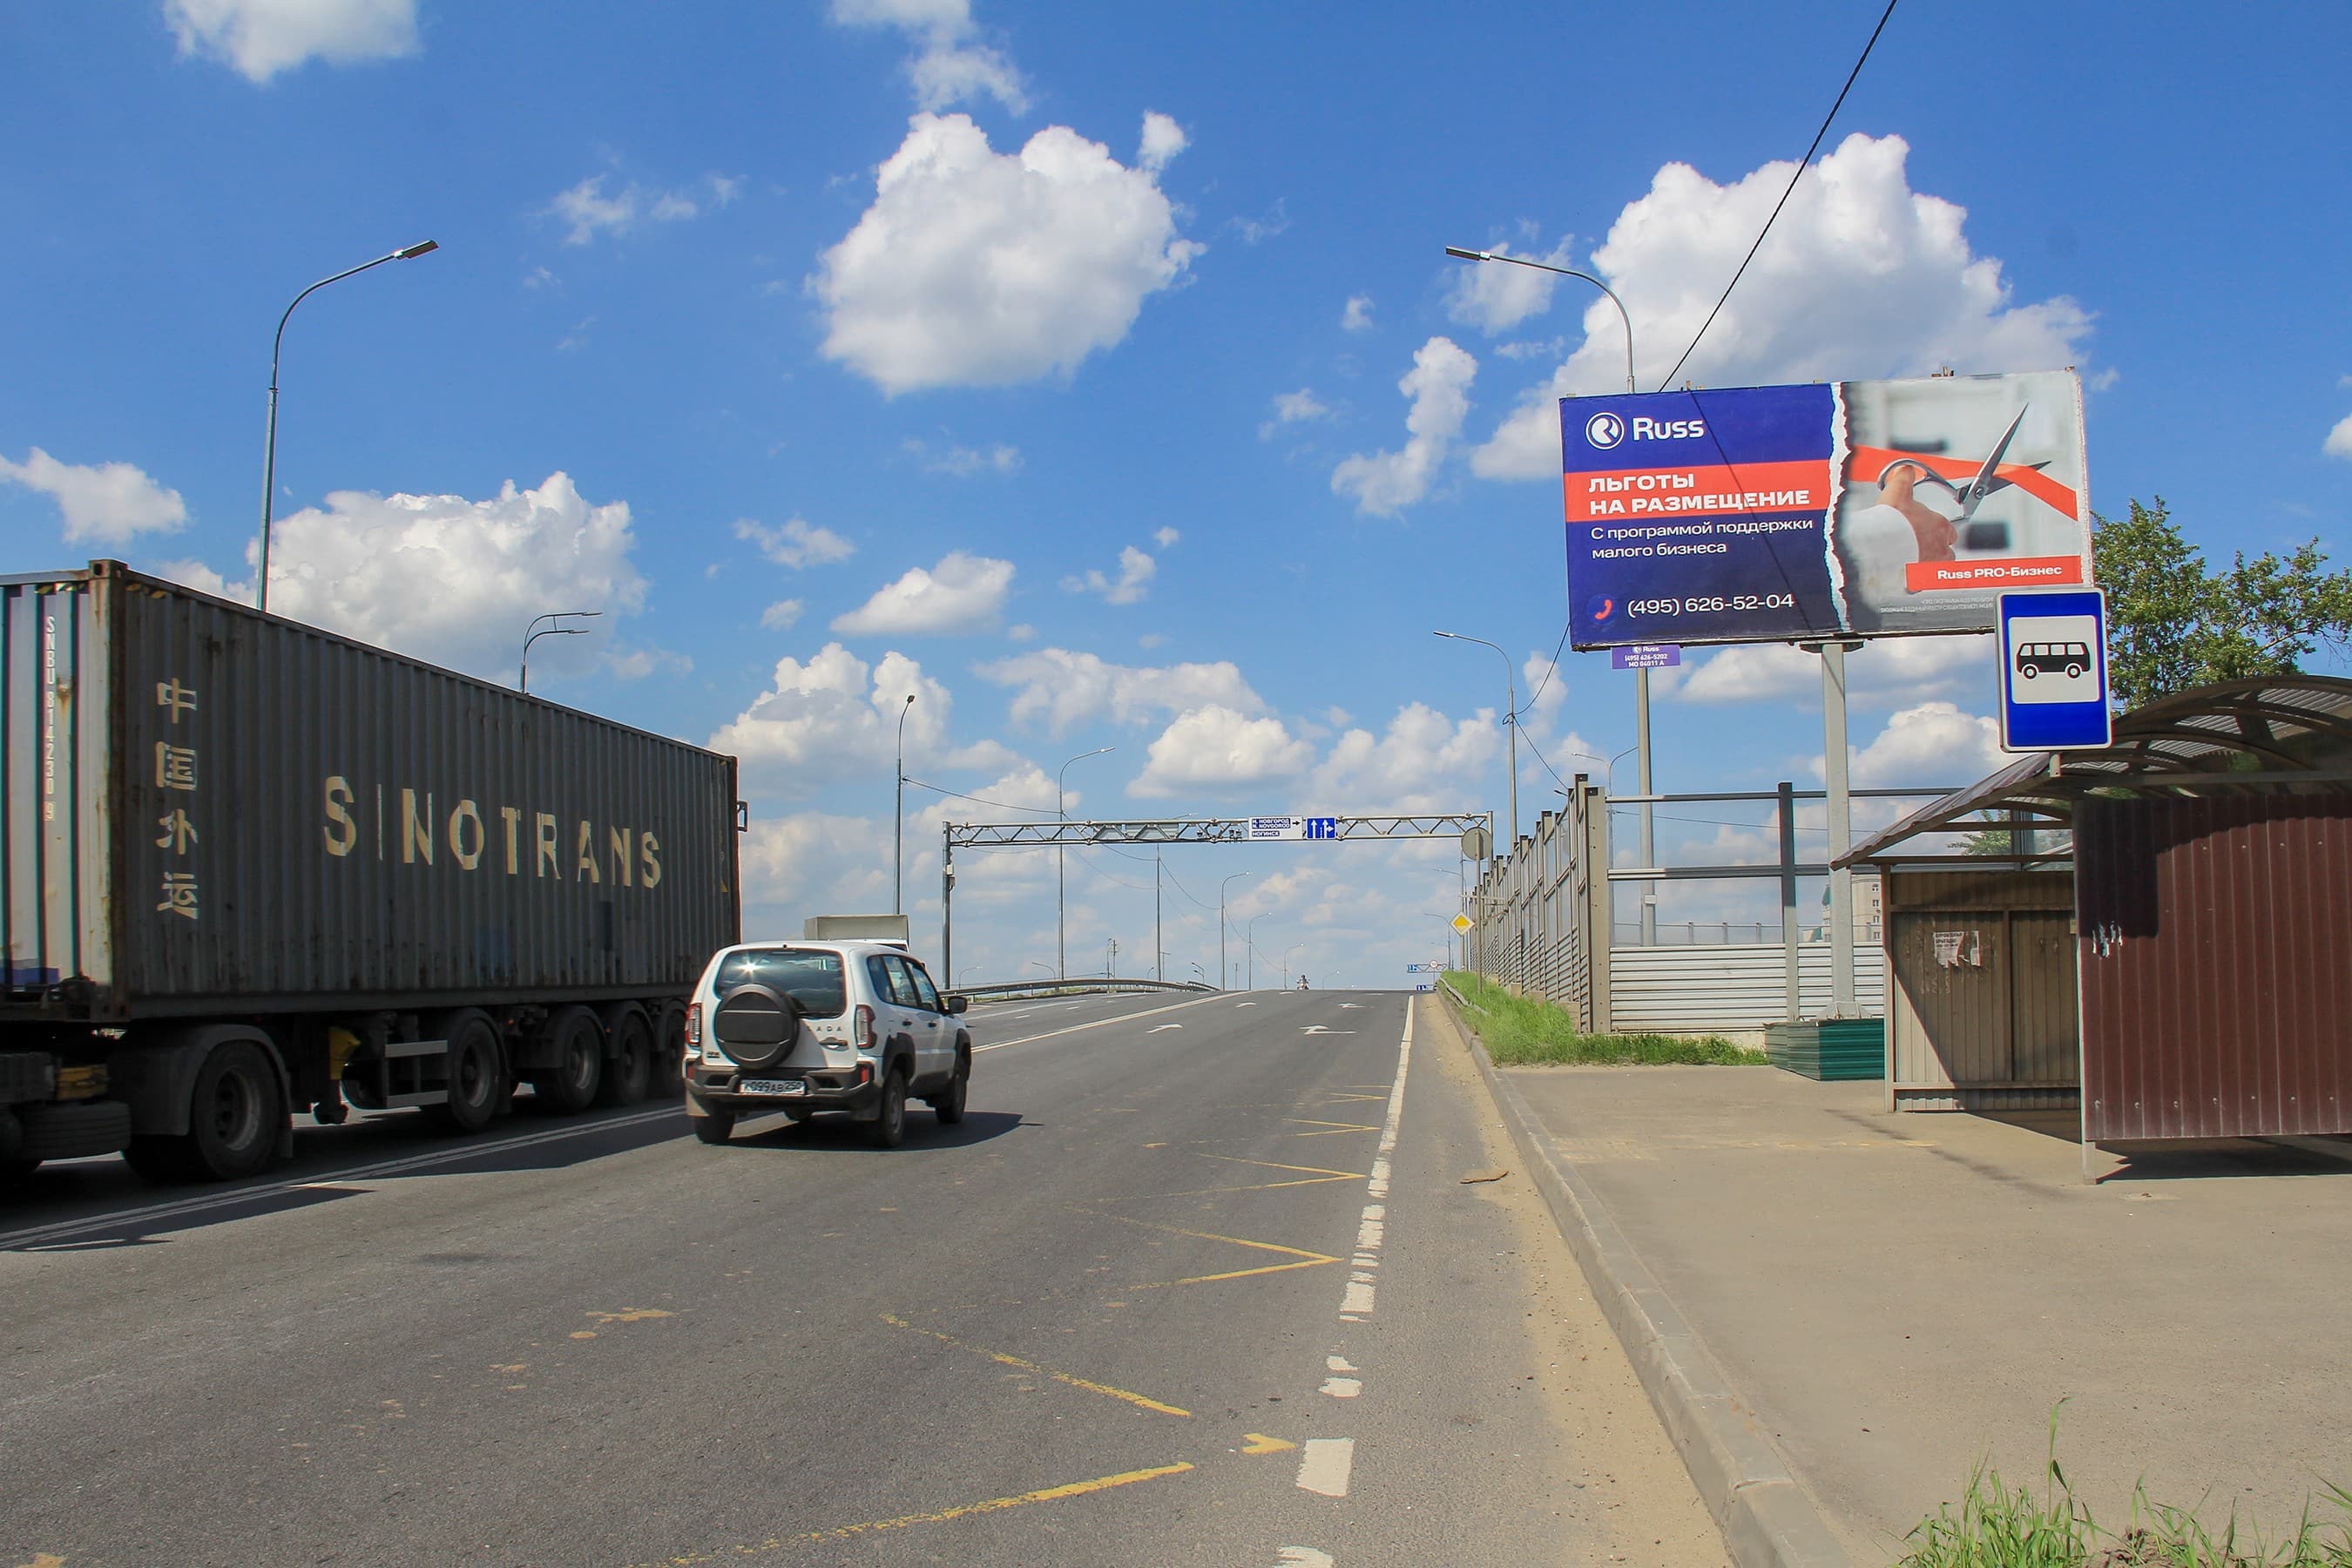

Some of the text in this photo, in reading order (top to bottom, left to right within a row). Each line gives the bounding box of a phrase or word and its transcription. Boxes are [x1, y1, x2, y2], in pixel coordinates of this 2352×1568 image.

[1632, 417, 1704, 441] Russ
[1588, 473, 1694, 493] ЛЬГОТЫ
[1590, 490, 1810, 515] НА РАЗМЕЩЕНИЕ
[1591, 519, 1813, 541] С программой поддержки
[1592, 543, 1727, 558] малого бизнеса
[1937, 566, 2063, 579] Russ PRO-Бизнес
[1627, 593, 1794, 618] (495) 626-52-04
[324, 775, 662, 889] SINOTRANS
